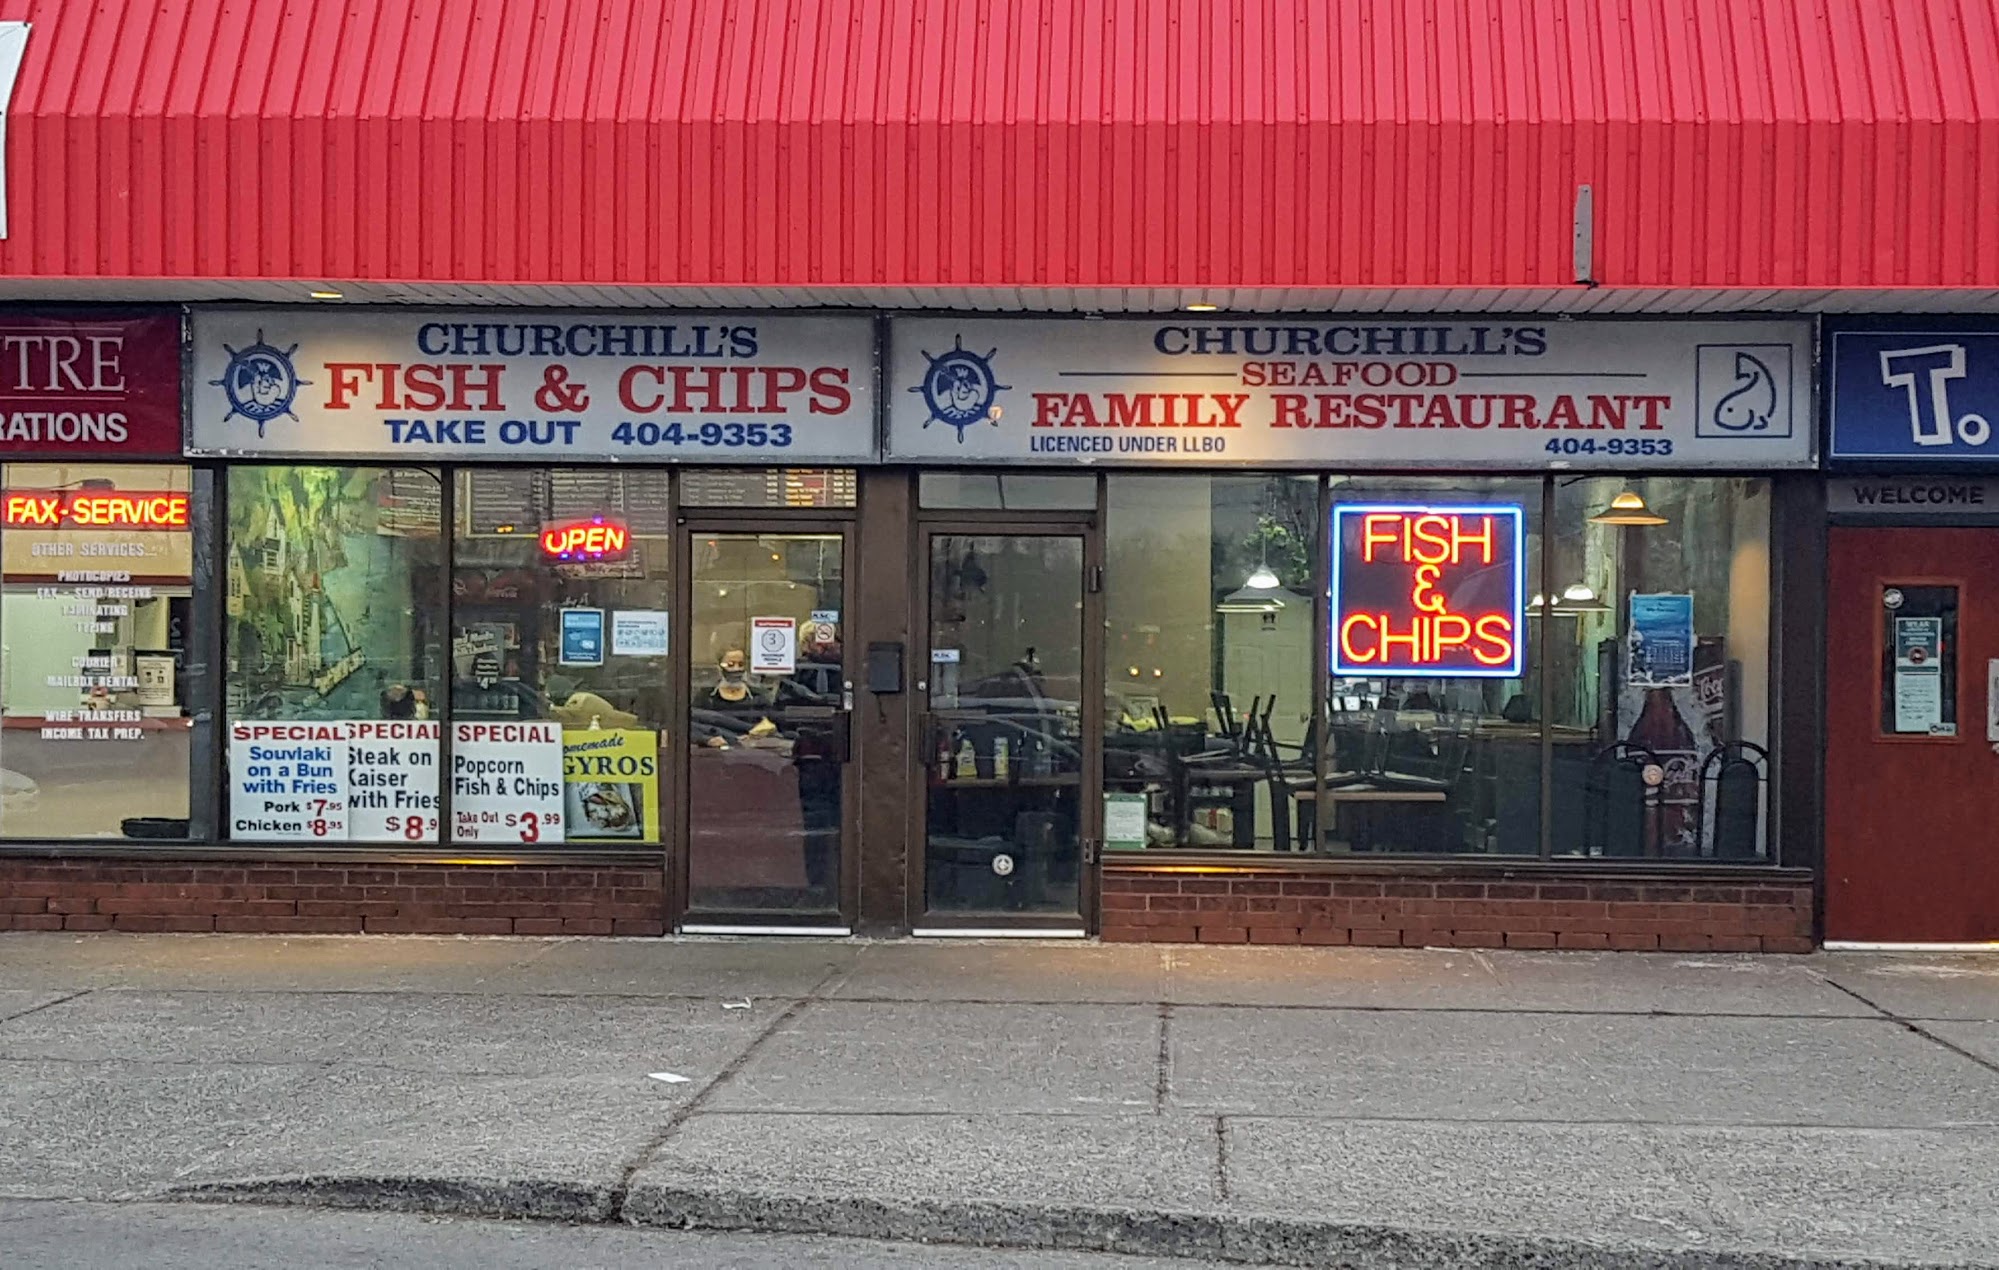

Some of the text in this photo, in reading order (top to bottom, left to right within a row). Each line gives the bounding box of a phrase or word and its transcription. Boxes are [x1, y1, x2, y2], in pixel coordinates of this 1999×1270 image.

[417, 323, 757, 358] CHURCHILL'S
[1153, 325, 1547, 356] CHURCHILL'S
[0, 335, 125, 392] TRE
[1242, 361, 1457, 387] SEAFOOD
[323, 363, 850, 415] FISH & CHIPS
[1031, 392, 1671, 431] FAMILY RESTAURANT
[384, 419, 793, 447] TAKE OUT 404-9353
[1030, 436, 1226, 453] LICENCED UNDER LLBO
[1545, 438, 1673, 456] 404-9353
[1854, 486, 1985, 505] WELCOME
[545, 527, 625, 553] OPEN
[1364, 514, 1493, 564] FISH
[32, 543, 74, 556] OTHER
[1412, 564, 1447, 615] &
[1341, 613, 1512, 665] CHIPS
[72, 656, 118, 668] COURIER
[97, 675, 139, 687] RENTAL
[45, 710, 141, 721] WIRE TRANSFERS
[41, 728, 145, 739] INCOME TAX PREP.
[234, 726, 345, 741] SPECIAL
[458, 725, 556, 742] SPECIAL
[249, 746, 331, 761] Souvlaki
[408, 750, 431, 766] on
[248, 763, 333, 777] on a Bun
[455, 755, 524, 779] Popcorn
[243, 779, 338, 794] with Fries
[455, 777, 559, 800] Fish & Chips
[264, 801, 300, 813] Pork
[235, 819, 302, 832] Chicken
[456, 811, 478, 824] Take
[481, 811, 499, 824] Out
[385, 815, 438, 840] $8.9
[456, 825, 479, 839] Only
